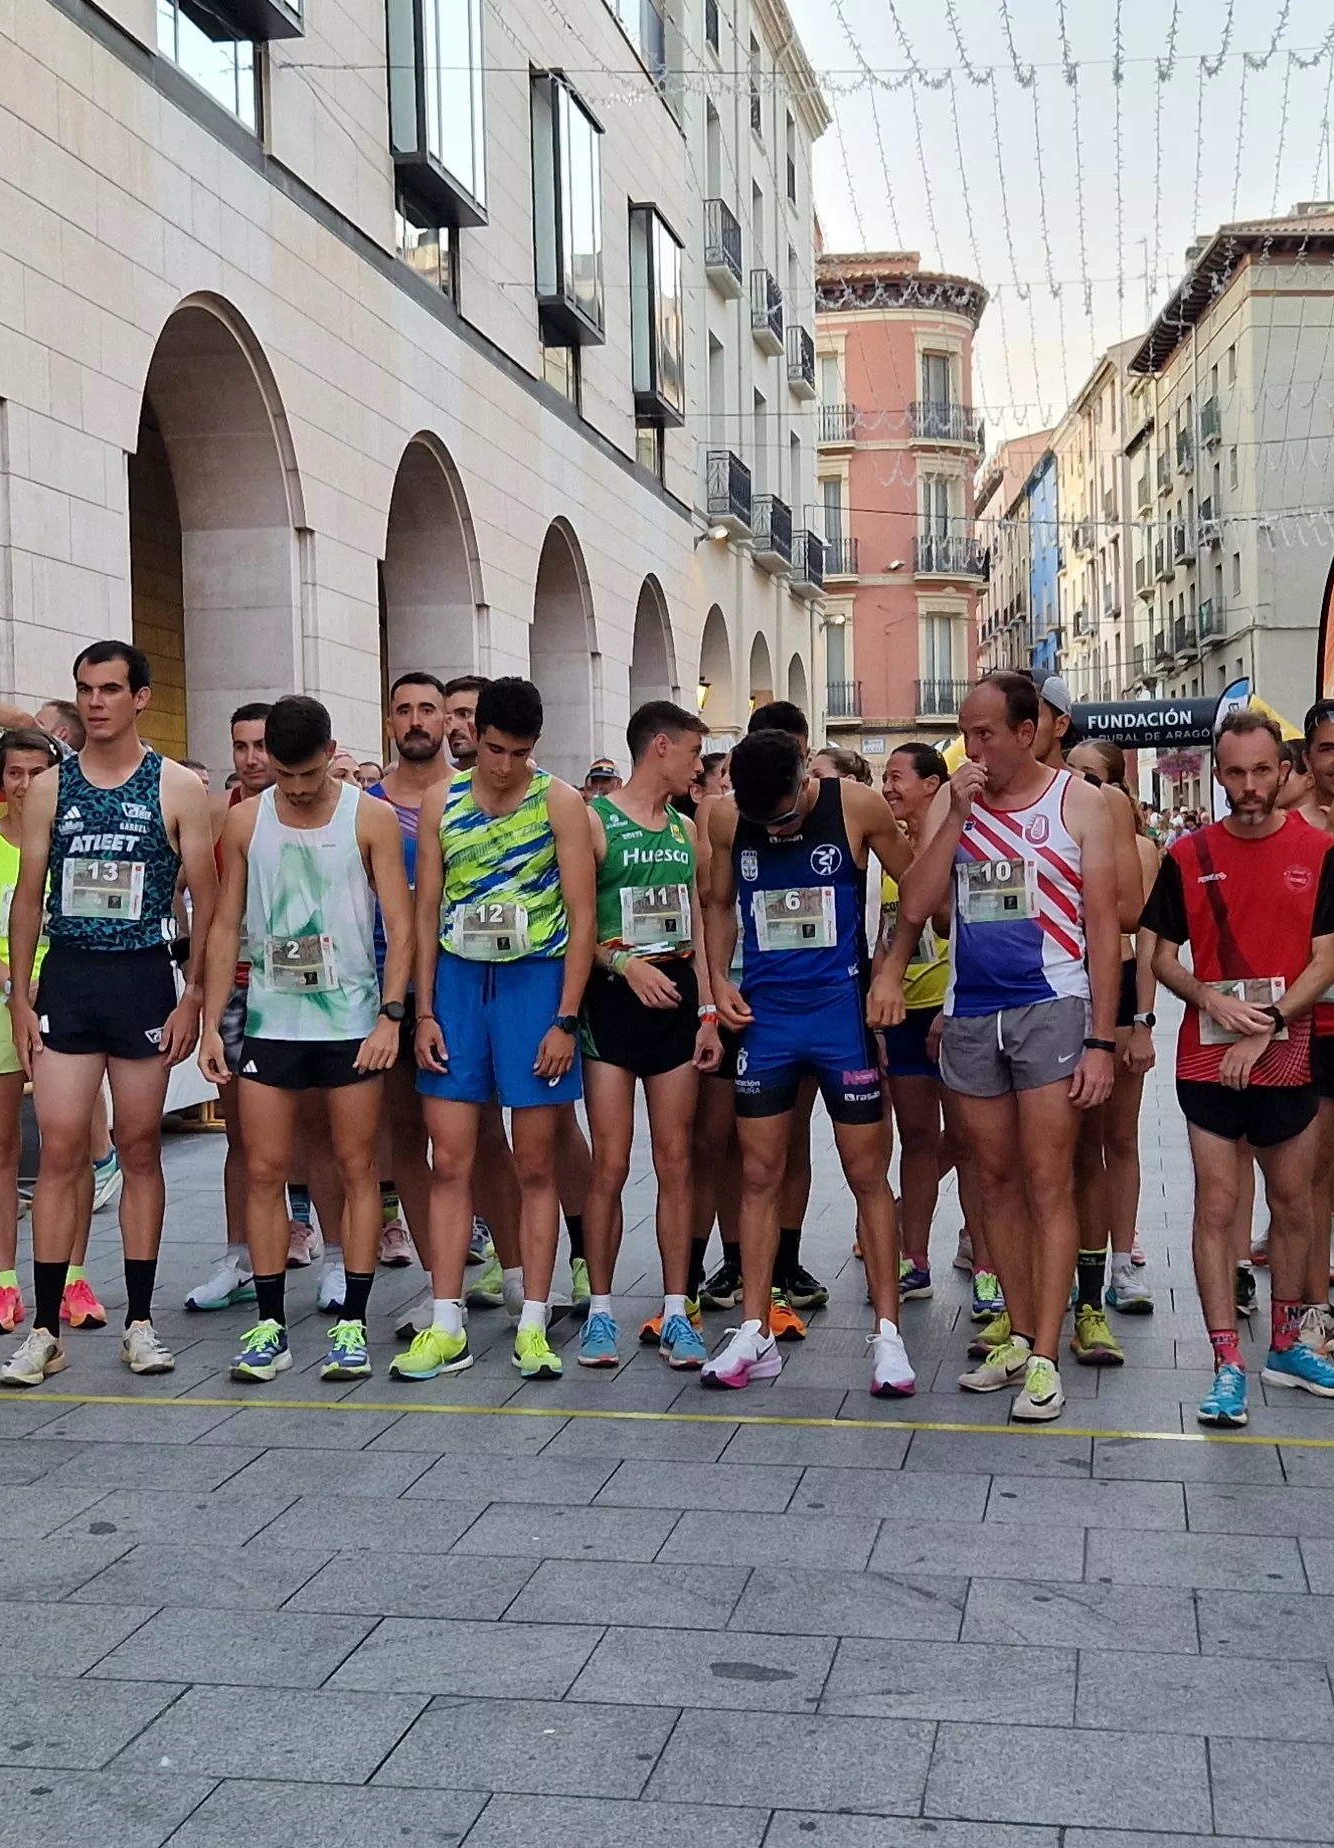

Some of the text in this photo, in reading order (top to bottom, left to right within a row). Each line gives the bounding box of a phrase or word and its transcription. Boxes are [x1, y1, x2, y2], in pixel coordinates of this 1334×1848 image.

[1087, 708, 1193, 730] FUNDACIÓN
[1145, 732, 1161, 742] DE
[69, 833, 140, 854] ATLEET
[623, 847, 689, 867] Huesca
[87, 861, 119, 882] 13
[981, 861, 1012, 882] 10
[645, 887, 668, 906] 11
[785, 891, 801, 911] 6
[476, 903, 504, 923] 12
[286, 940, 302, 959] 2
[1231, 981, 1247, 1000] 1
